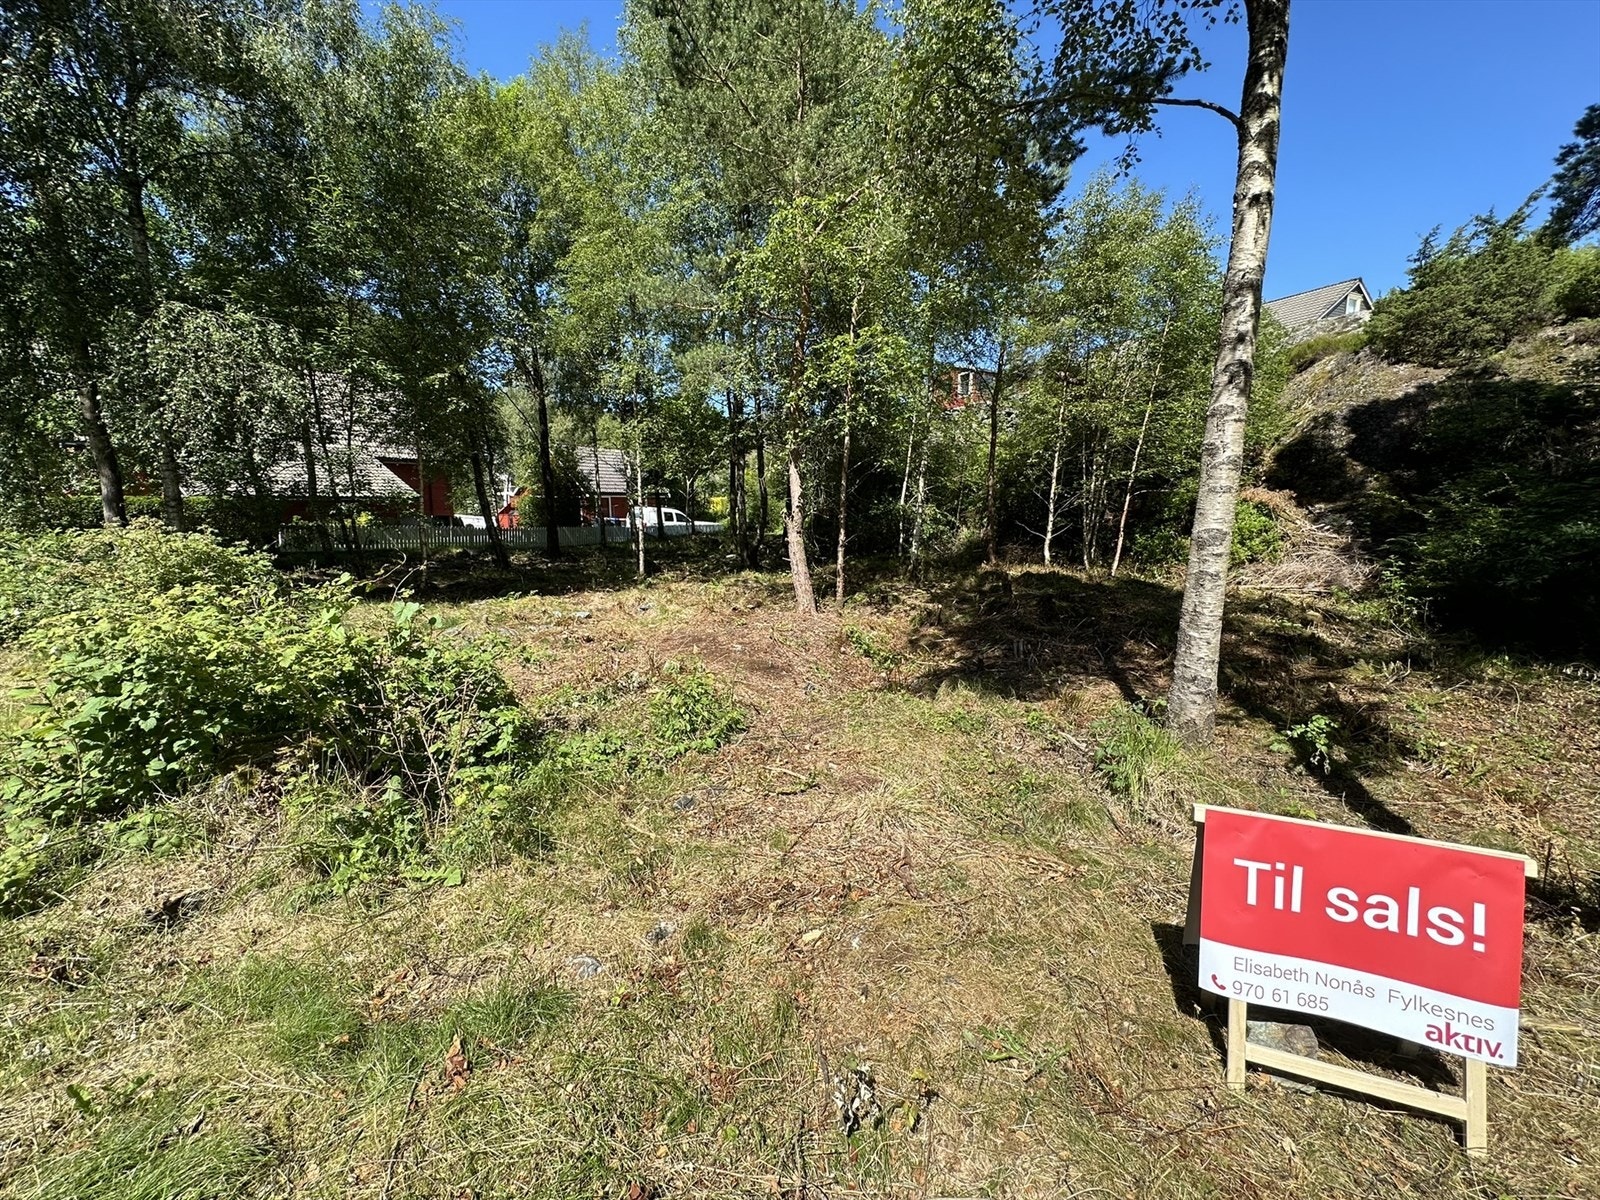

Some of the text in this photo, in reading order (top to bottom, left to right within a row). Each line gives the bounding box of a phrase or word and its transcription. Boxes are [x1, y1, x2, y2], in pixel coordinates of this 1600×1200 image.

[1233, 858, 1486, 953] Til sals!
[1232, 980, 1329, 1012] 970 61 685
[1233, 956, 1495, 1032] Elisabeth Nonås Fylkesnes
